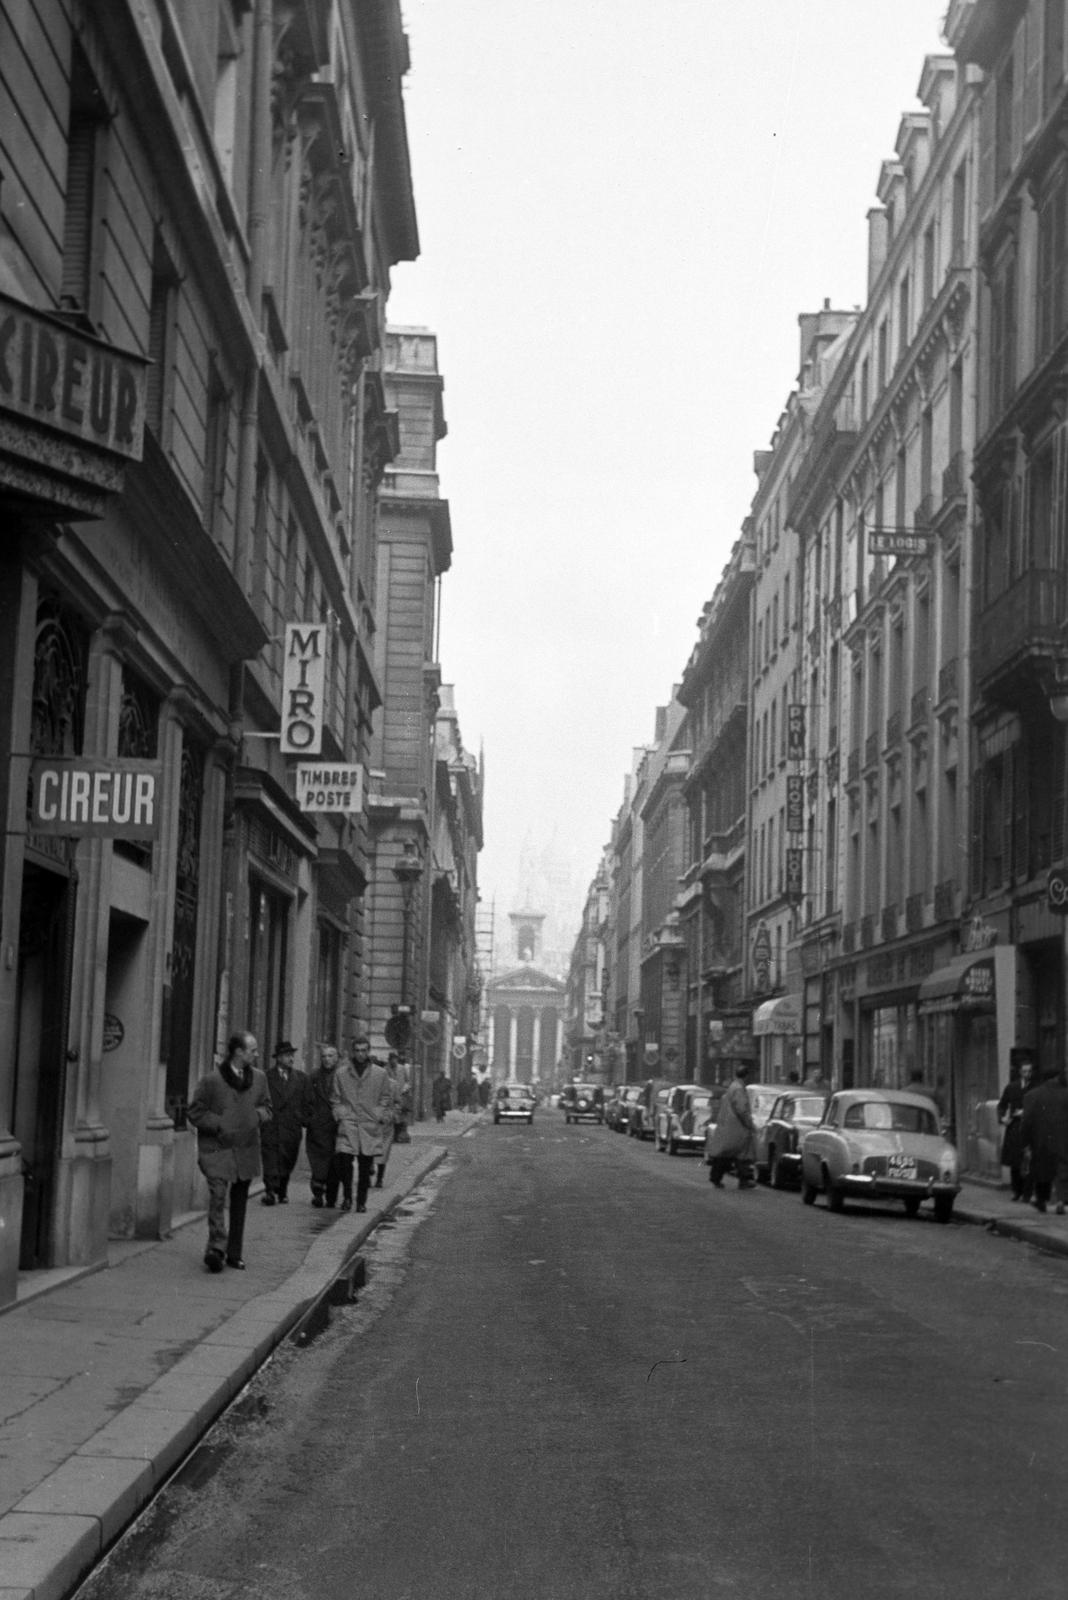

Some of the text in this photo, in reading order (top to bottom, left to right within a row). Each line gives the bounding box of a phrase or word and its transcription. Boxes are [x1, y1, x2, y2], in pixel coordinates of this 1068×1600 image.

[286, 629, 322, 749] MIRO
[39, 770, 155, 824] CIREUR
[300, 770, 358, 787] TIMBRES
[305, 790, 352, 807] POSTE
[788, 778, 801, 830] ROSE
